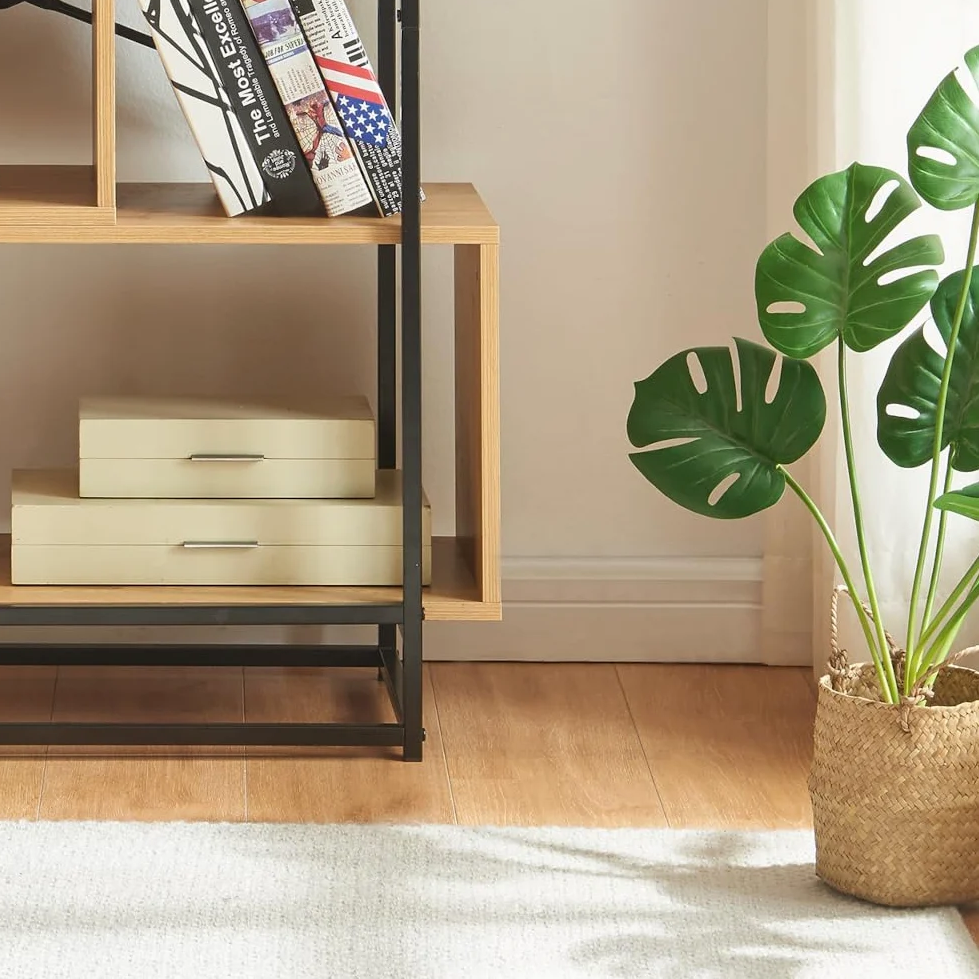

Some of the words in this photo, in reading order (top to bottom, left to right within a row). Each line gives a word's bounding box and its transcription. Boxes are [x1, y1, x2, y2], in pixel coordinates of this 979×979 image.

[224, 8, 238, 36] Romeo
[233, 36, 242, 44] of
[239, 46, 255, 77] Tragedy
[228, 59, 256, 106] Most
[252, 78, 273, 122] Lamentable
[250, 109, 270, 145] The
[268, 123, 280, 138] and
